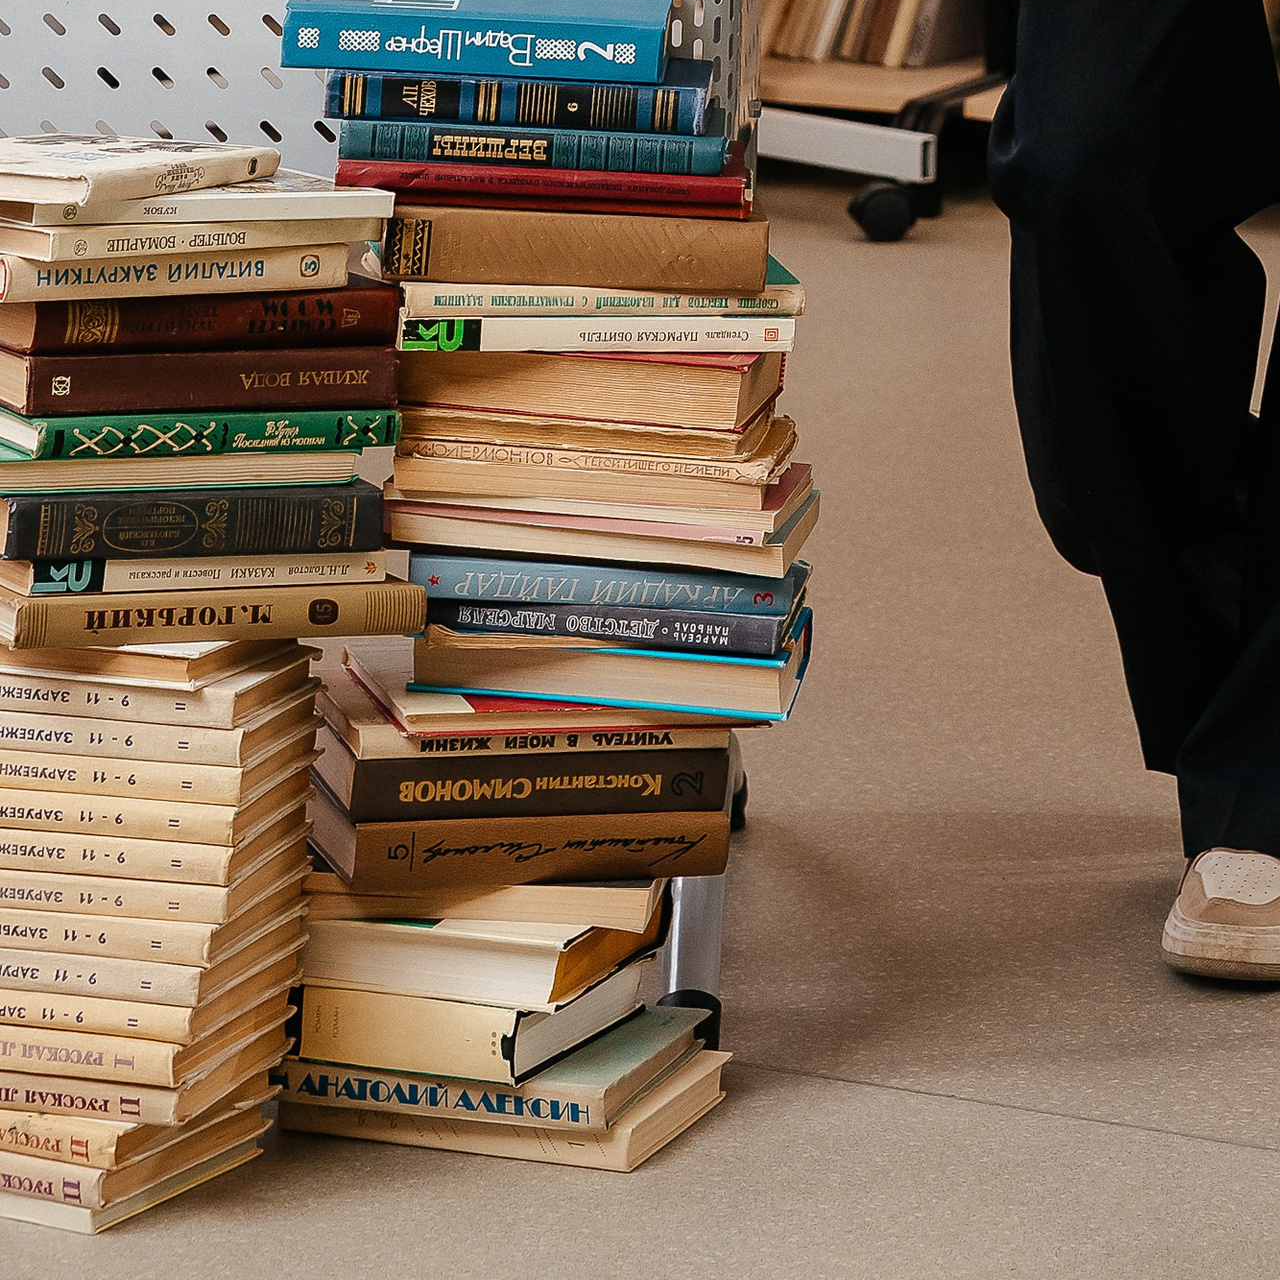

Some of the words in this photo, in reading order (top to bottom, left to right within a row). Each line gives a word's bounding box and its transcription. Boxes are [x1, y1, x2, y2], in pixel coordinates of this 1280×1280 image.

[384, 26, 462, 62] Шефнер
[465, 31, 533, 67] Вадим
[419, 80, 437, 116] ЧЕХОВ
[432, 133, 548, 161] ВЕРШИНЫ
[143, 206, 178, 215] КУБОК
[107, 235, 177, 253] БОМАРШЕ
[189, 231, 247, 248] ВОЛЬТЕР
[36, 263, 159, 287] ЗАКРУТКИН
[167, 259, 265, 283] ВИТАЛИЙ
[579, 328, 633, 342] ОБИТЕЛЬ
[637, 328, 699, 342] ПАРМСКАЯ
[705, 330, 749, 341] Стендаль
[240, 371, 291, 389] ВОДА
[298, 369, 370, 386] ЖИВАЯ
[128, 570, 173, 581] рассказы
[182, 568, 222, 580] Повести
[230, 566, 276, 578] КАЗАКИ
[453, 572, 580, 603] ГАЙДАР
[592, 579, 745, 609] АРКАДИЙ
[84, 605, 236, 636] ГОРЬКИЙ
[458, 606, 556, 631] МАРСЕЛЯ
[566, 615, 659, 639] ДЕТСТВО
[674, 622, 730, 635] ПАНЬОЛЬ
[674, 633, 729, 646] МАРСЕЛЬ
[420, 737, 492, 752] ЖИЗНИ
[504, 735, 556, 749] МОЕЙ
[567, 734, 578, 748] В
[592, 731, 674, 746] УЧИТЕЛЬ
[399, 776, 532, 804] СИМОНОВ
[536, 773, 662, 797] Константин
[21, 1043, 104, 1067] РУССКАЯ
[25, 1088, 110, 1113] РУССКАЯ
[299, 1073, 449, 1107] АНАТОЛИЙ
[453, 1089, 590, 1124] АЛЕКСИН
